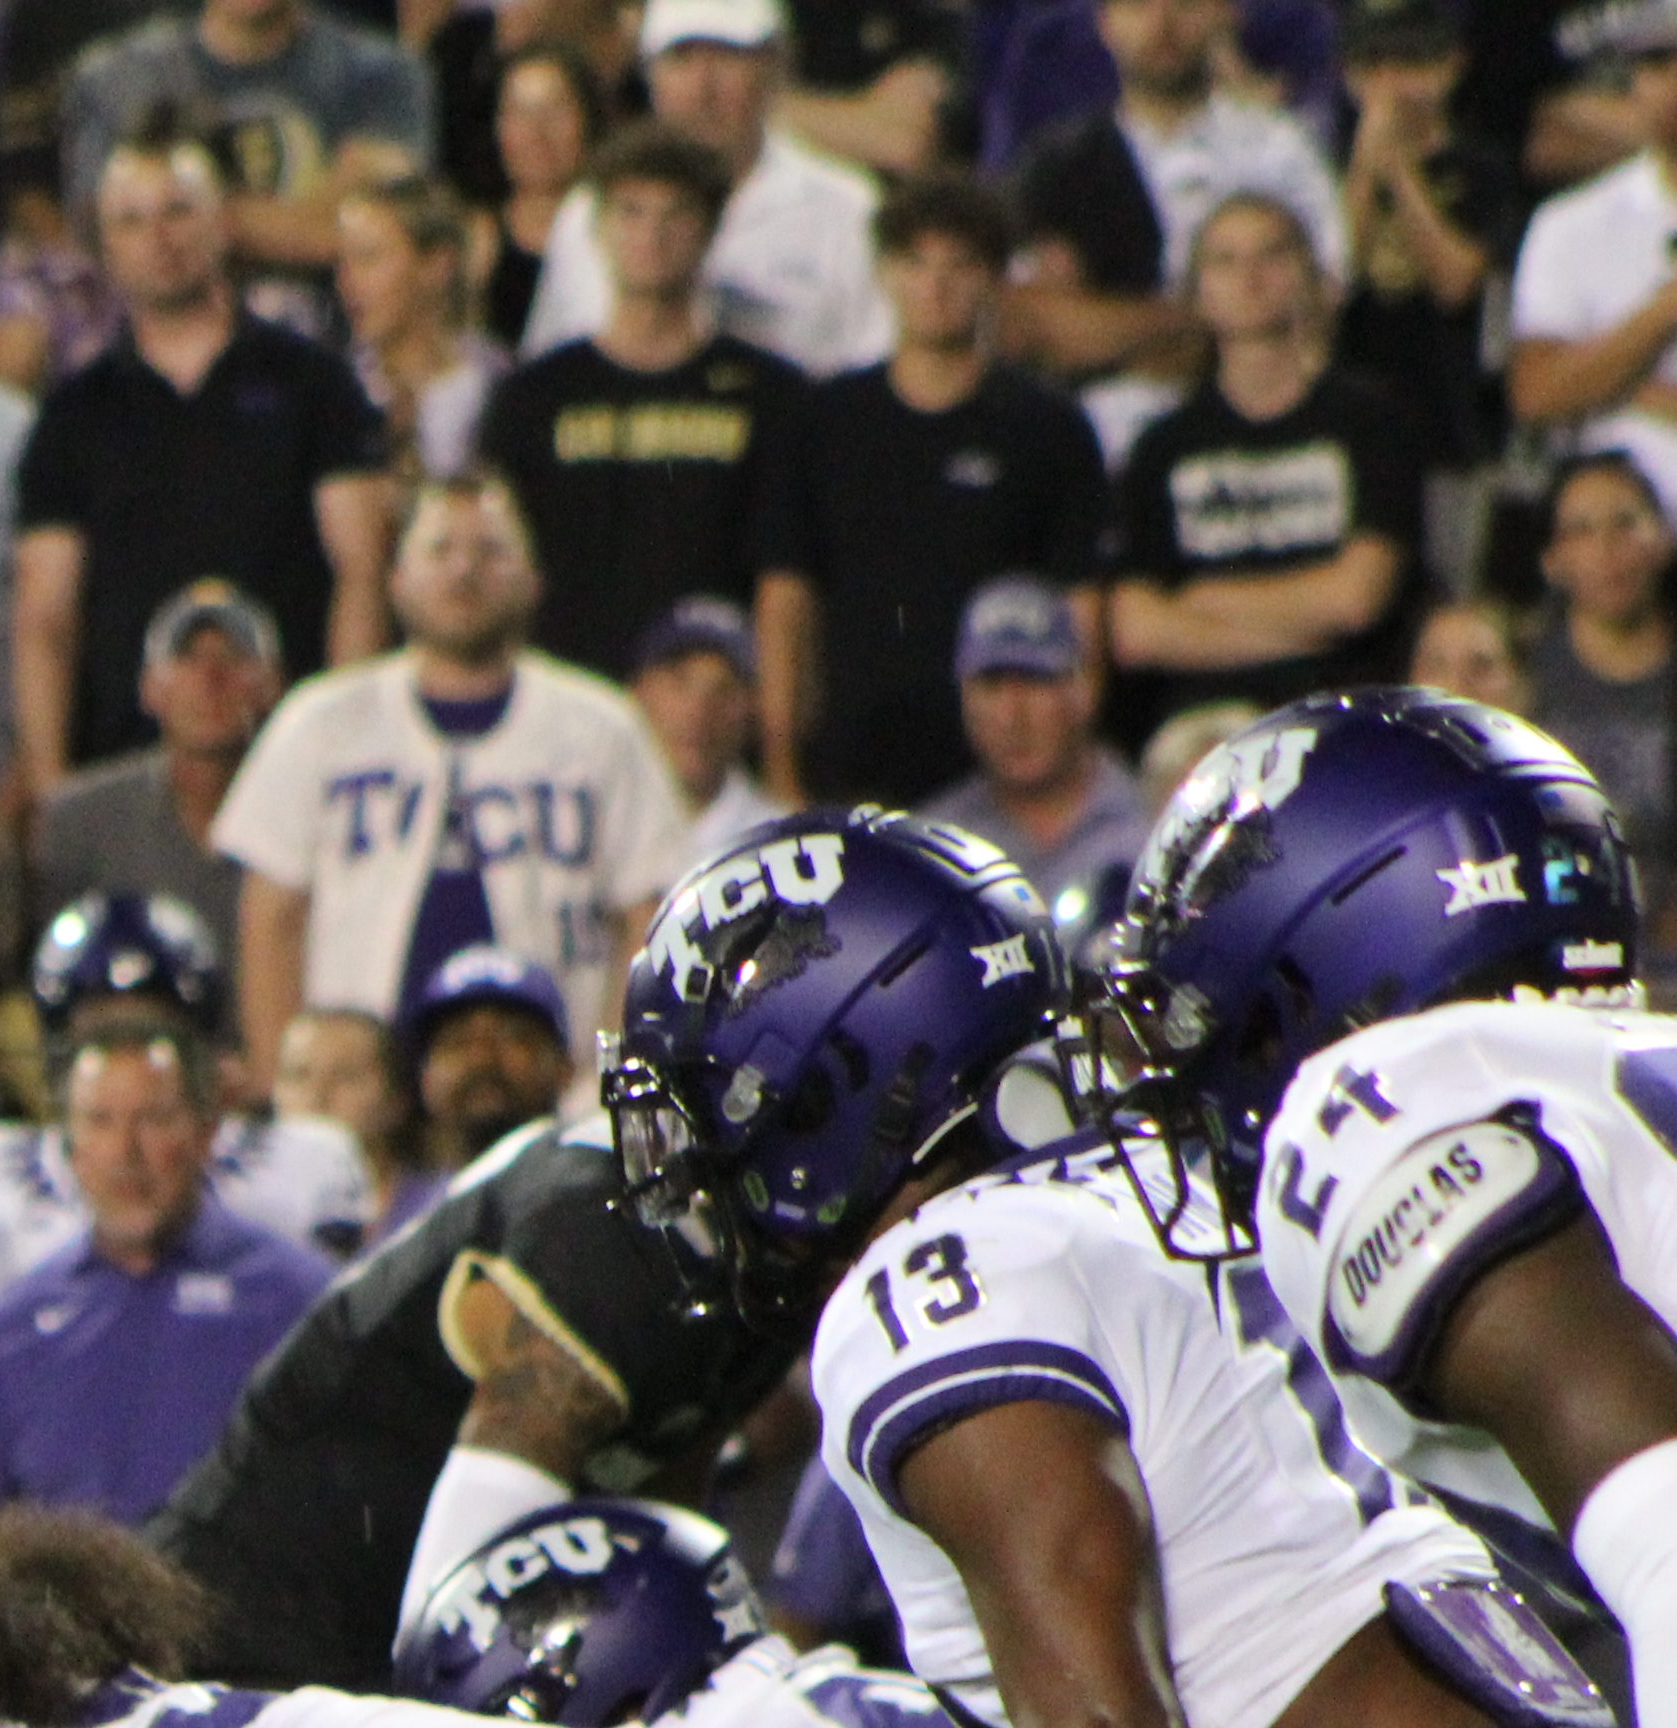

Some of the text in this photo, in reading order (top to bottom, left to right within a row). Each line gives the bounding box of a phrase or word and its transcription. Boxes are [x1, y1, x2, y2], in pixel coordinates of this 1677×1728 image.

[644, 834, 845, 1002] TCU
[1435, 853, 1527, 917] XII
[969, 933, 1036, 988] XII
[1269, 1063, 1403, 1241] 24
[1342, 1142, 1482, 1308] DOUGLAS
[864, 1233, 980, 1355] 13
[428, 1516, 614, 1653] TCU
